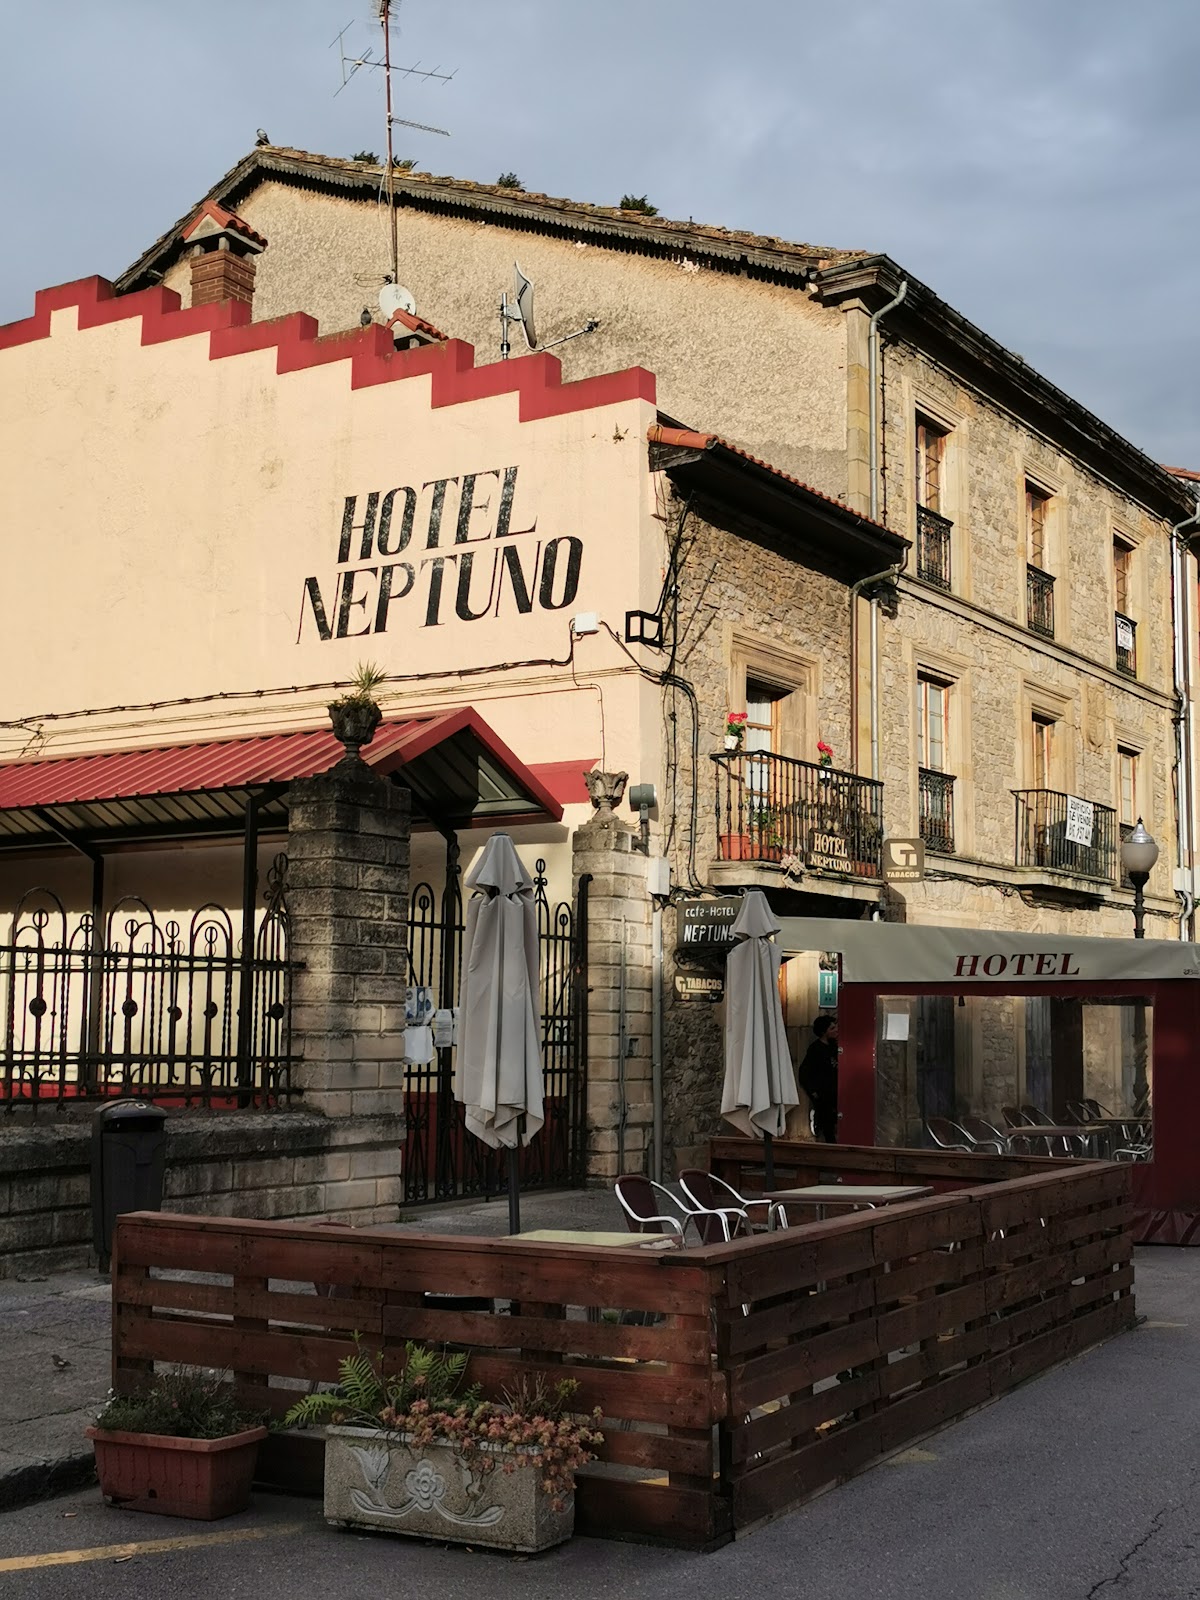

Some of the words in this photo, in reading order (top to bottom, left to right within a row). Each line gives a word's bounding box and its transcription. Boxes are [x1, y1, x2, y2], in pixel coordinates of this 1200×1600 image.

[337, 465, 538, 564] HOTEL
[295, 536, 583, 644] NEPTUNO
[813, 832, 847, 858] HOTEL
[810, 853, 852, 873] NEPTUNO
[953, 953, 1080, 977] HOTEL
[687, 976, 723, 990] TABACOS
[824, 975, 833, 994] H
